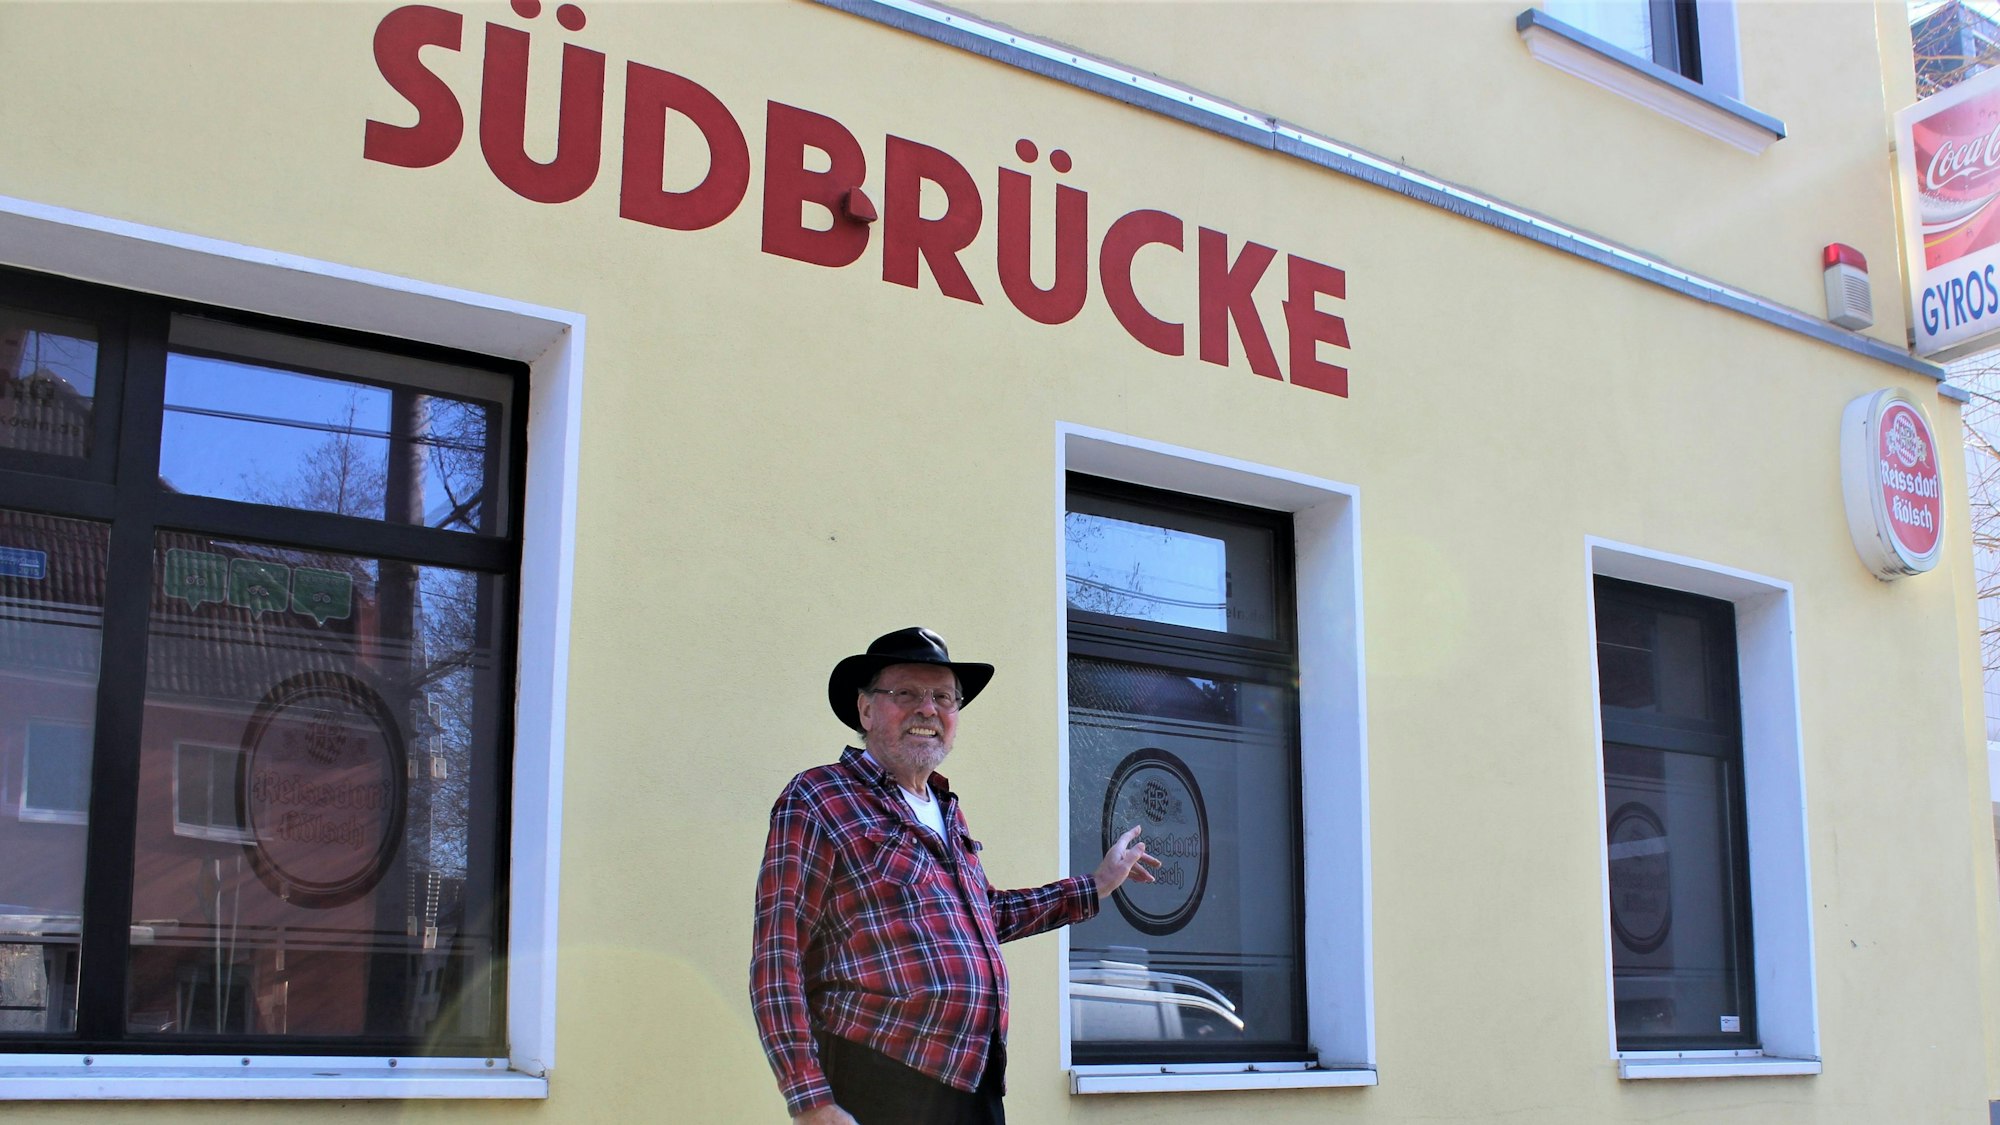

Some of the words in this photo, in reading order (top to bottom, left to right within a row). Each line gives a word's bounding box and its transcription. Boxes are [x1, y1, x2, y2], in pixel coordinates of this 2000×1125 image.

[1926, 122, 2000, 190] Coca-C
[363, 0, 1351, 398] SÜDBRÜCKE
[1921, 264, 1999, 336] GYROS
[1880, 460, 1938, 499] Reissdorf
[1892, 495, 1933, 532] Kölsch
[1114, 826, 1200, 858] ssdorf
